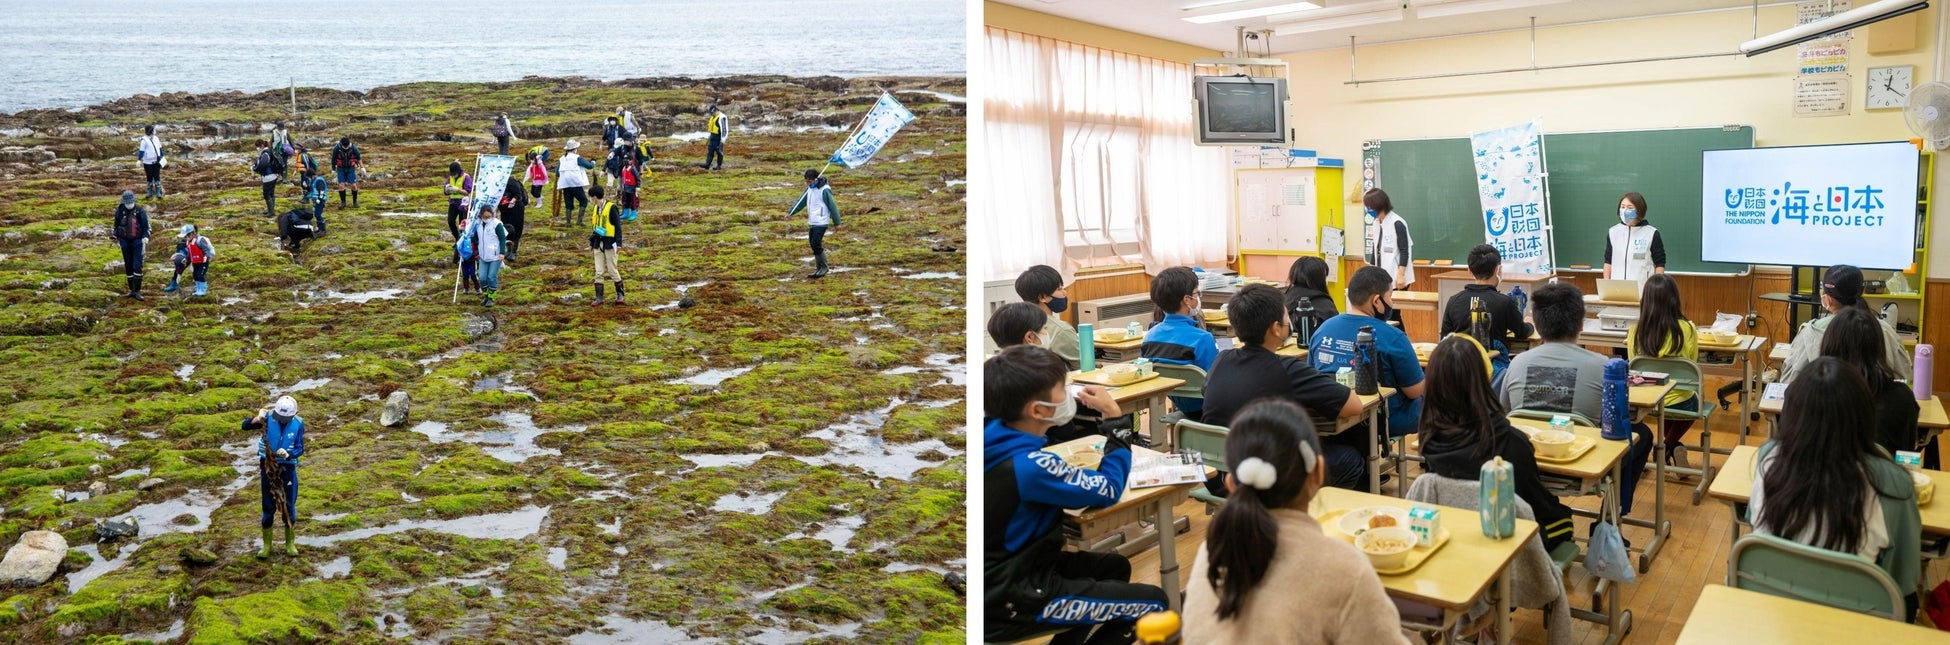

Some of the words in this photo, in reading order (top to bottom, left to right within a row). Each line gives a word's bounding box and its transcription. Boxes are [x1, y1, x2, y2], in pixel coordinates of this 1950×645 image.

[1801, 65, 1846, 74] 学校もピカピカ
[1745, 188, 1766, 198] 日本
[1745, 199, 1766, 209] 財団
[1770, 181, 1884, 225] 海と日本
[1510, 203, 1538, 218] 日本
[1512, 217, 1540, 233] 財団
[1813, 215, 1884, 226] PROJECT
[1509, 250, 1543, 259] PROJECT
[1529, 385, 1569, 395] OUTDOOR
